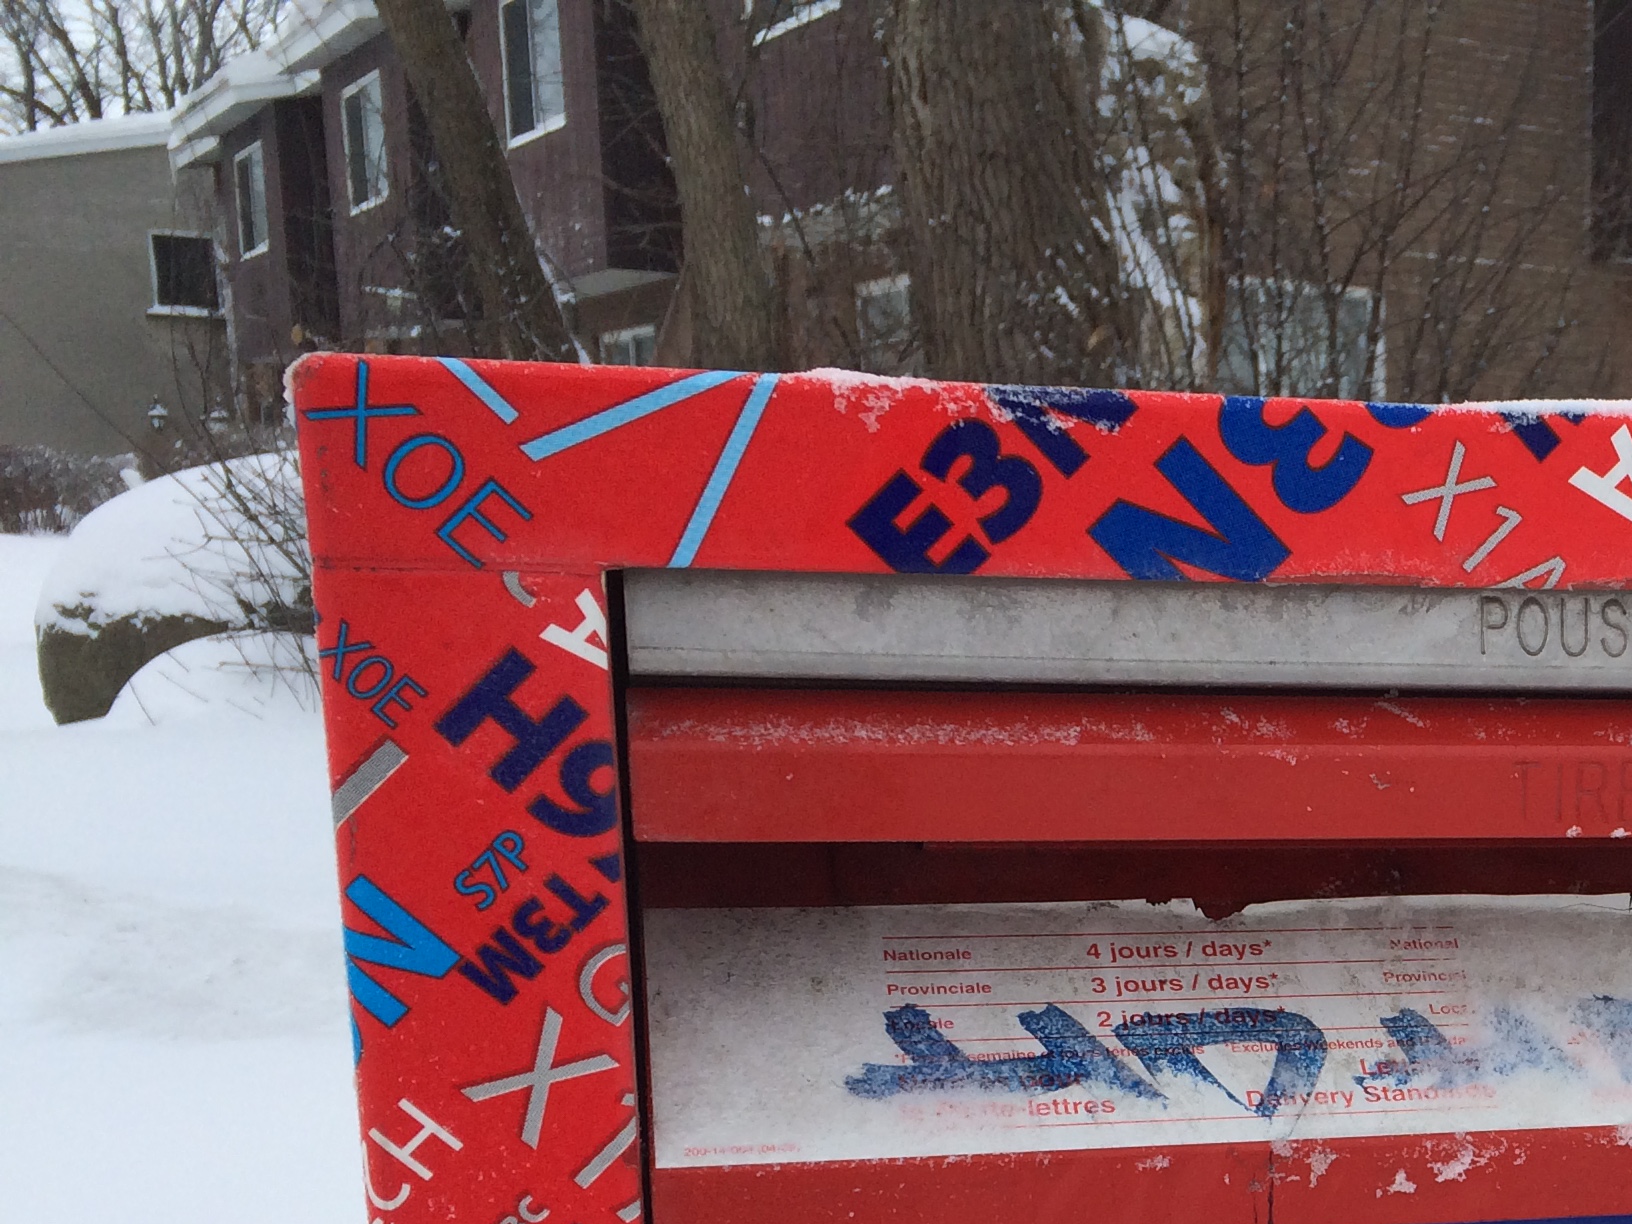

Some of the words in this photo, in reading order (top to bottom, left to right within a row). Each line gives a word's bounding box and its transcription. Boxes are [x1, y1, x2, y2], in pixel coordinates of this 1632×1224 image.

[453, 829, 529, 911] S7P
[883, 948, 972, 962] Nationale
[1086, 943, 1102, 960] 4
[1110, 941, 1178, 963] jours
[887, 983, 993, 997] Provinciale
[1091, 978, 1107, 995] 3
[1116, 975, 1184, 997] jours
[1097, 1011, 1112, 1028] 2
